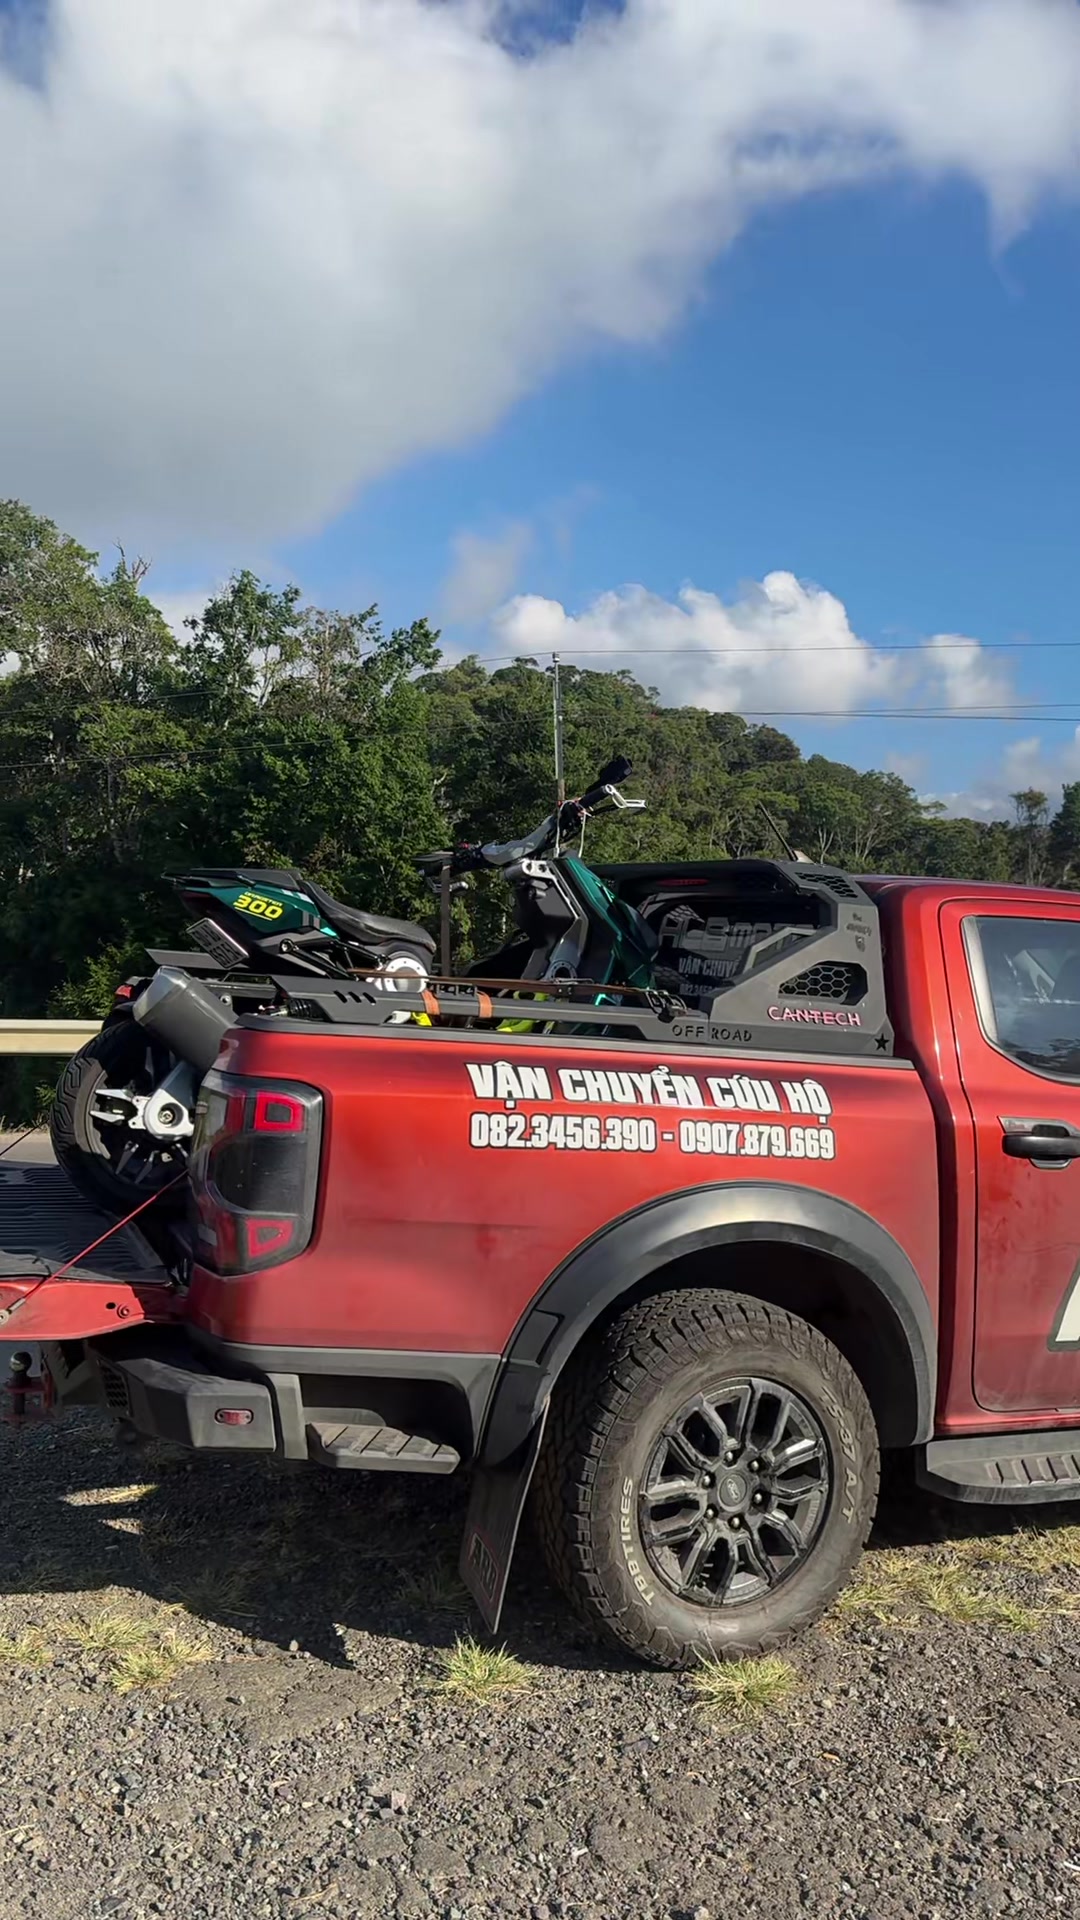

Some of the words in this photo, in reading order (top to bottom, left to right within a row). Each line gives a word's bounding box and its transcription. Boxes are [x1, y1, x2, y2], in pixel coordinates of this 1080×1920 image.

[233, 895, 283, 919] 300
[672, 1024, 704, 1037] OFF
[711, 1027, 752, 1042] ROAD
[768, 1006, 861, 1026] CANTECH
[466, 1060, 553, 1109] VẬN
[557, 1065, 705, 1108] CHUYỂN
[706, 1074, 781, 1112] CỨU
[780, 1078, 832, 1124] HỘ
[470, 1113, 656, 1151] 082.3456.390
[662, 1132, 674, 1141] -
[679, 1120, 835, 1159] 0907.879.669
[842, 1467, 858, 1524] A/T
